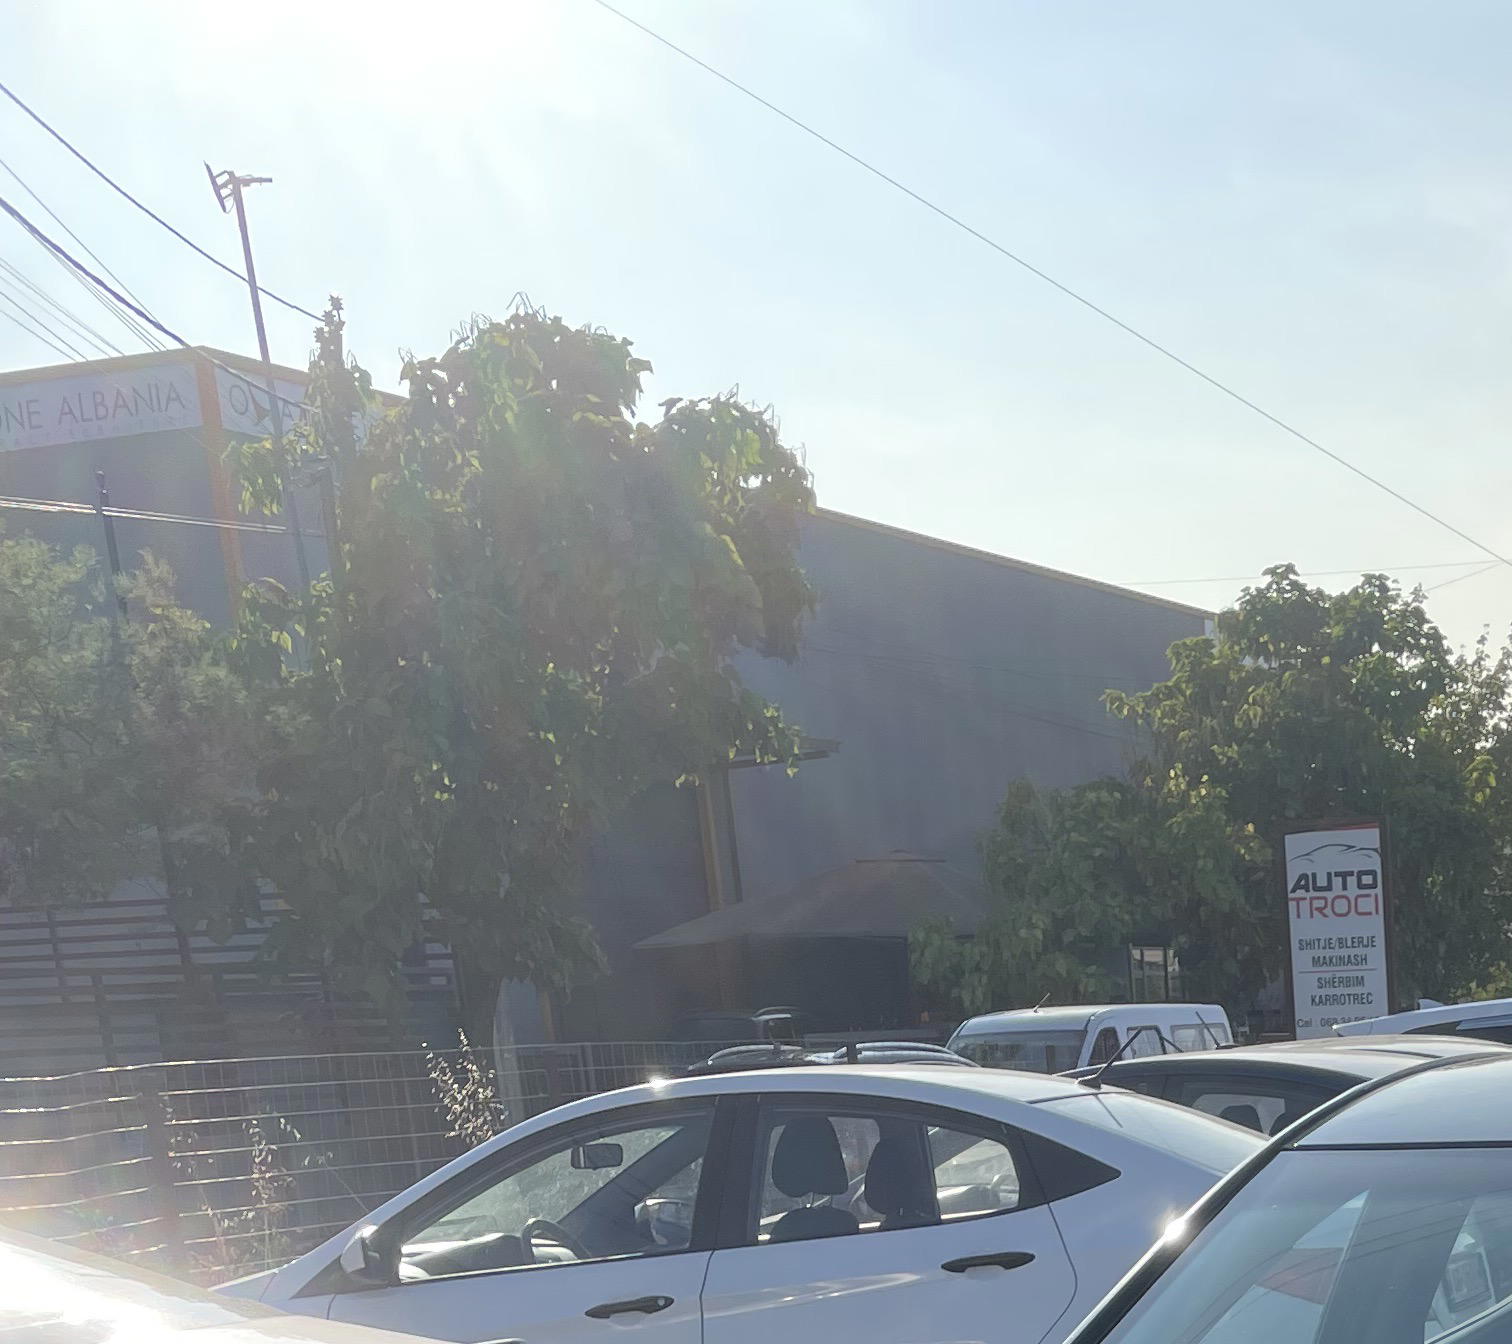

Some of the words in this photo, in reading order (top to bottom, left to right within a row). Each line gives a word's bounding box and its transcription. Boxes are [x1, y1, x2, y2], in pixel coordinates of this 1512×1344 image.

[0, 400, 43, 433] NE
[58, 382, 186, 426] ALBANIA
[1290, 869, 1378, 893] AUTO
[1289, 894, 1379, 919] TROCI
[1298, 936, 1376, 951] SHITJE/BLERJE
[1312, 954, 1368, 968] MAKINASH
[1317, 974, 1365, 989] SHËRBIM
[1311, 992, 1373, 1007] KARROTREC
